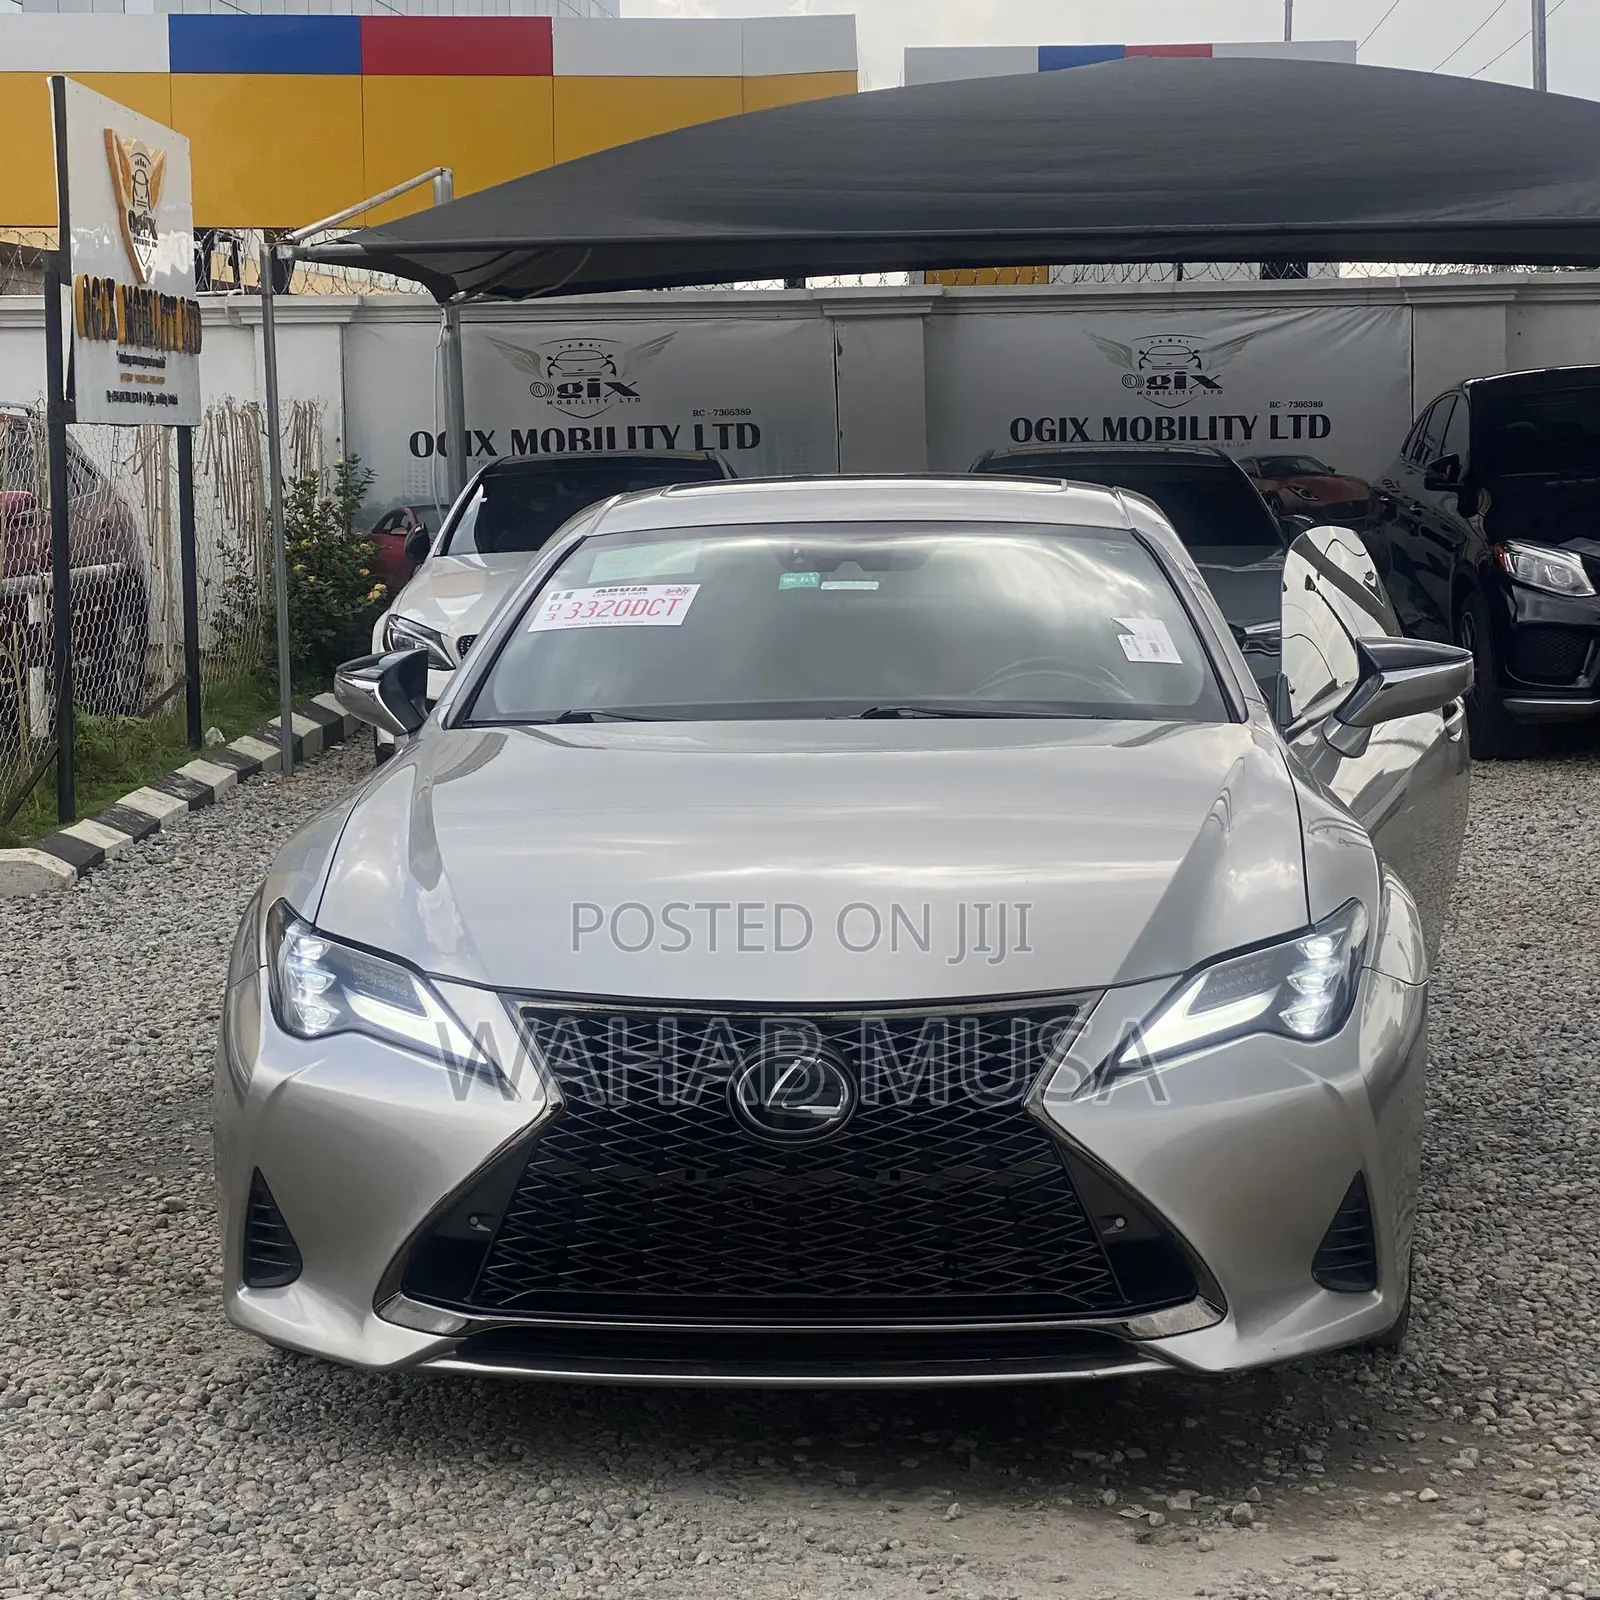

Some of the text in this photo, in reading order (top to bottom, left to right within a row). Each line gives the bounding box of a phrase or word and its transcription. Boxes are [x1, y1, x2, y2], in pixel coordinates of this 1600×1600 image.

[529, 377, 640, 399] Ogix
[1121, 371, 1223, 390] Ogix
[692, 409, 705, 417] RC
[713, 408, 751, 417] 7366389
[1269, 401, 1282, 409] RC
[1288, 400, 1323, 409] 7366389
[1010, 414, 1332, 442] OGIX MOBILITY LTD
[511, 424, 681, 456] MOBILITY
[694, 423, 761, 451] LTD
[564, 598, 684, 620] 3320DCT
